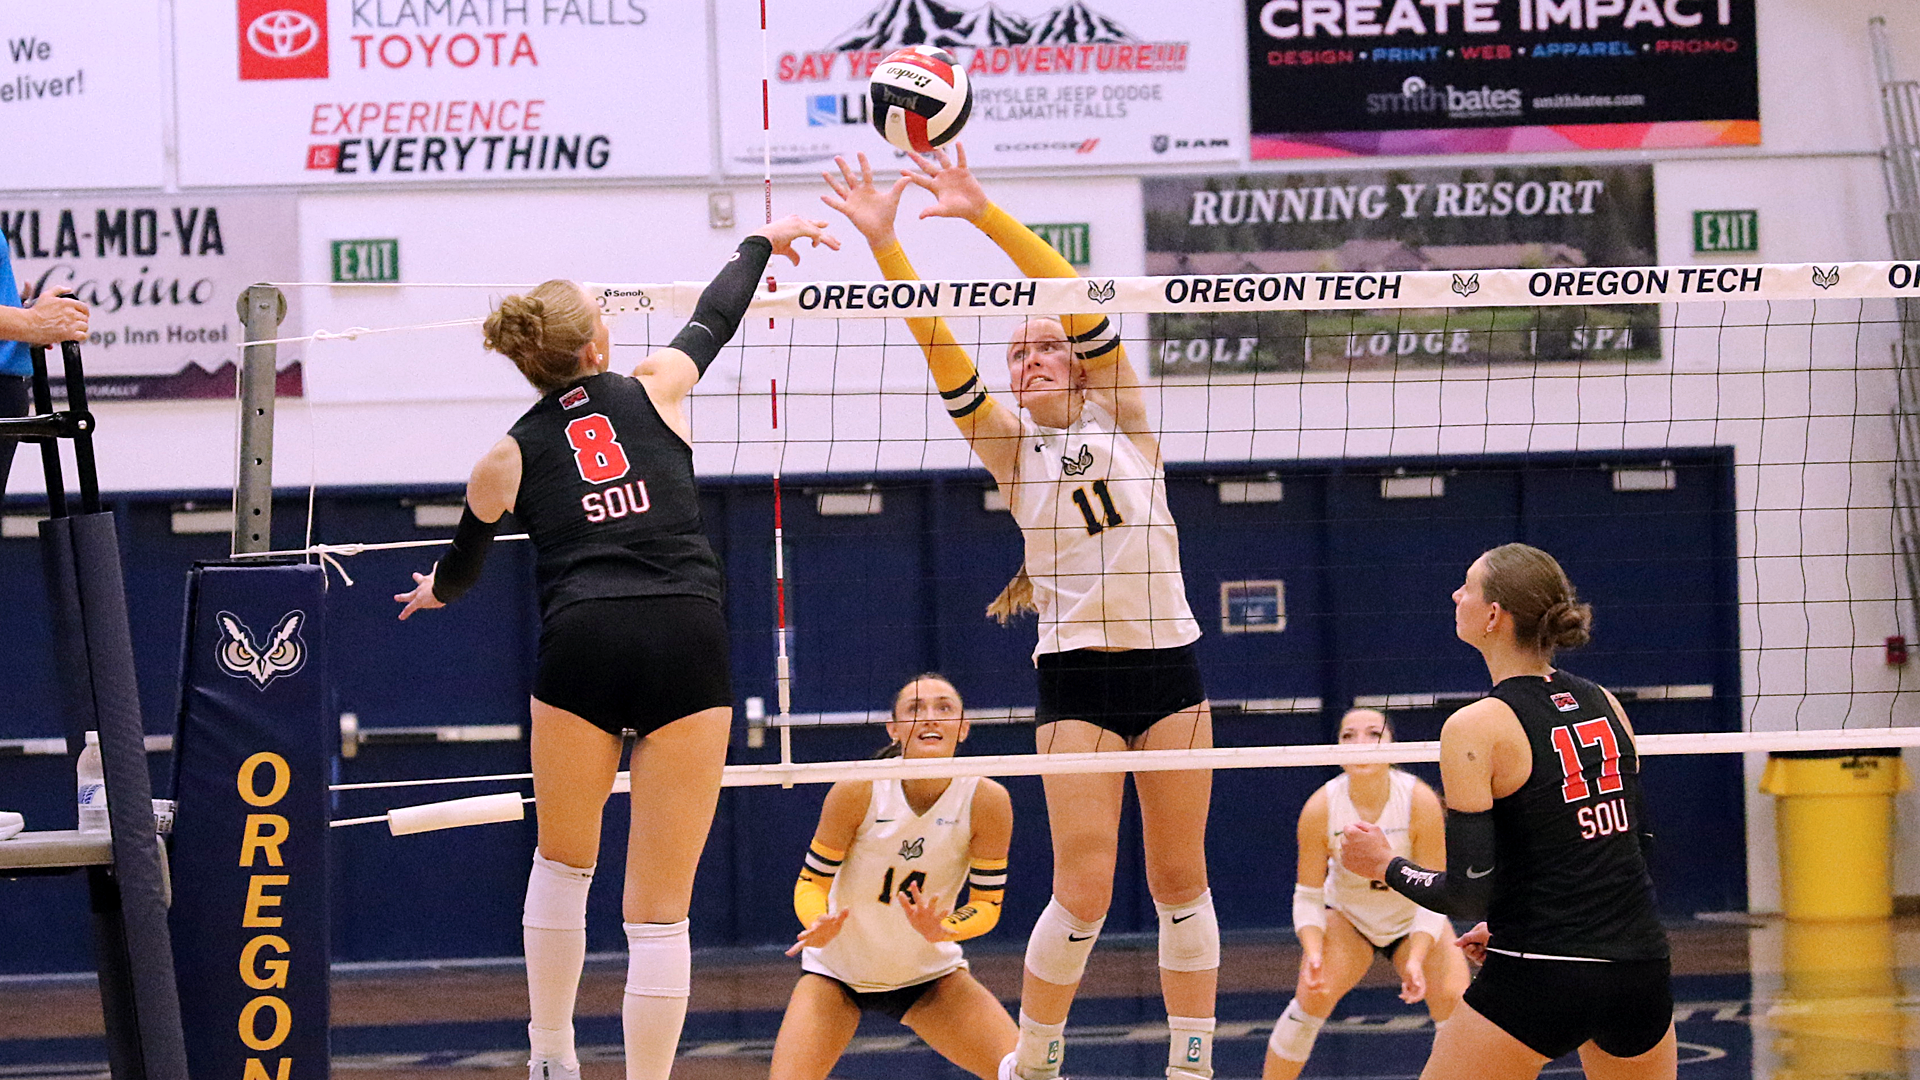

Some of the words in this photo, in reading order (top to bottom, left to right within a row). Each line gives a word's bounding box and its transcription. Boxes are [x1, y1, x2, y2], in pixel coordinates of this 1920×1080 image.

[352, 0, 528, 29] KLAMATH
[543, 0, 648, 26] FALLS
[1259, 0, 1500, 38] CREATE
[1519, 0, 1732, 32] IMPACT
[9, 37, 51, 63] We
[351, 33, 539, 69] TOYOTA
[777, 53, 836, 83] SAY
[846, 49, 881, 80] YE
[967, 44, 1189, 75] ADVENTURE!!!
[1267, 49, 1354, 66] DESIGN
[1372, 47, 1441, 63] PRINT
[1461, 45, 1512, 60] WEB
[1532, 40, 1636, 58] APPAREL
[1655, 37, 1738, 54] PROMO
[0, 69, 84, 102] eliver!
[886, 66, 933, 88] Baden
[971, 86, 1048, 104] HRYSLER
[1056, 86, 1097, 102] JEEP
[1102, 84, 1163, 101] DODGE
[310, 100, 546, 135] EXPERIENCE
[984, 103, 1068, 121] KLAMATH
[1073, 102, 1128, 118] FALLS
[313, 148, 330, 166] IS
[334, 135, 611, 174] EVERYTHING
[1189, 184, 1387, 226] RUNNING
[1398, 182, 1426, 217] Y
[1434, 179, 1604, 217] RESORT
[0, 206, 225, 259] KLA-MO-YA
[1701, 213, 1752, 249] EXIT
[340, 243, 392, 279] EXIT
[24, 263, 214, 314] Casino
[612, 289, 644, 297] Senoh
[799, 283, 942, 311] OREGON
[949, 280, 1037, 308] TECH
[1164, 275, 1306, 304] OREGON
[1315, 274, 1403, 301] TECH
[1528, 269, 1669, 298] OREGON
[1677, 267, 1763, 294] TECH
[124, 326, 160, 344] Inn
[166, 324, 228, 344] Hotel
[1158, 336, 1259, 364] GOLF
[1343, 328, 1471, 359] LODGE
[1570, 326, 1635, 352] SPA
[564, 412, 631, 485] 8
[581, 480, 651, 523] SOU
[1072, 477, 1125, 537] 11
[1550, 716, 1623, 804] 17
[1576, 798, 1629, 840] SOU
